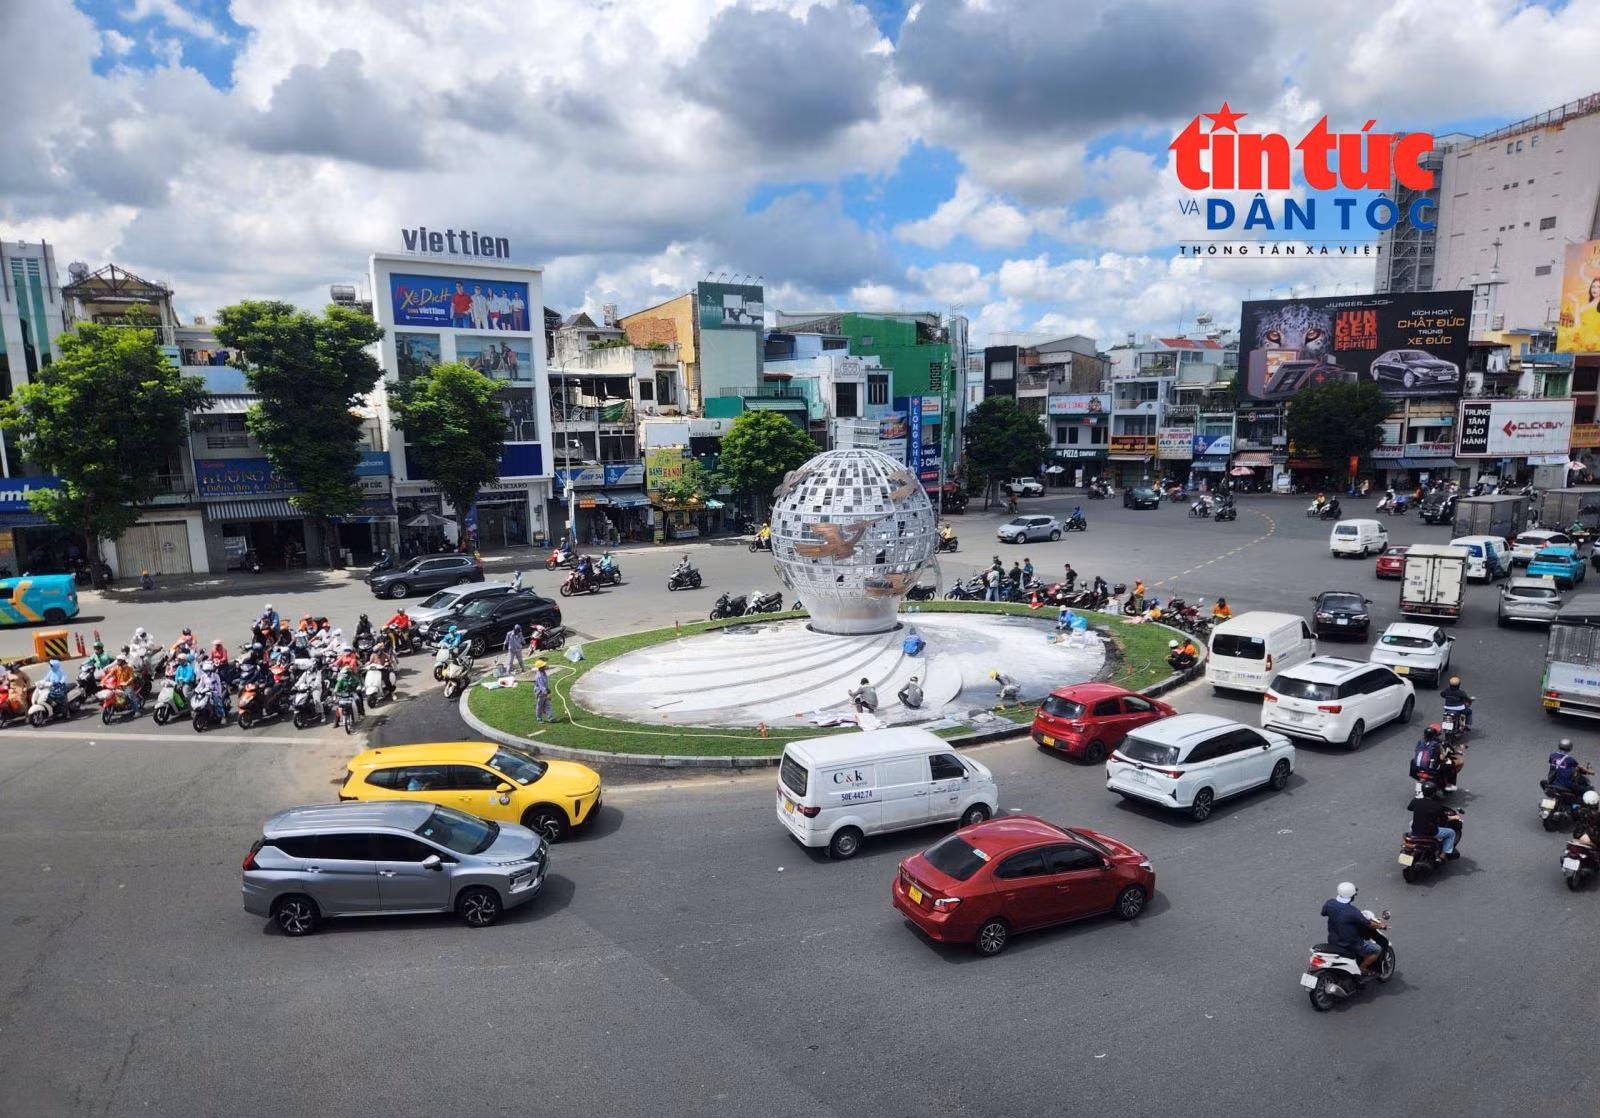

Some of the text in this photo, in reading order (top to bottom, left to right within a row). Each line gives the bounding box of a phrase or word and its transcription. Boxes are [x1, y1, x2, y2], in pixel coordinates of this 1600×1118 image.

[402, 226, 510, 258] viettien
[1336, 310, 1377, 324] JUN
[1436, 316, 1465, 328] ĐỨC
[1426, 335, 1452, 345] ĐỨC
[1468, 417, 1486, 426] TÂM
[1517, 421, 1565, 430] CLICKBUY
[1466, 426, 1484, 435] BẢO
[1462, 436, 1487, 445] HÀNH
[1063, 449, 1079, 457] PIZZA
